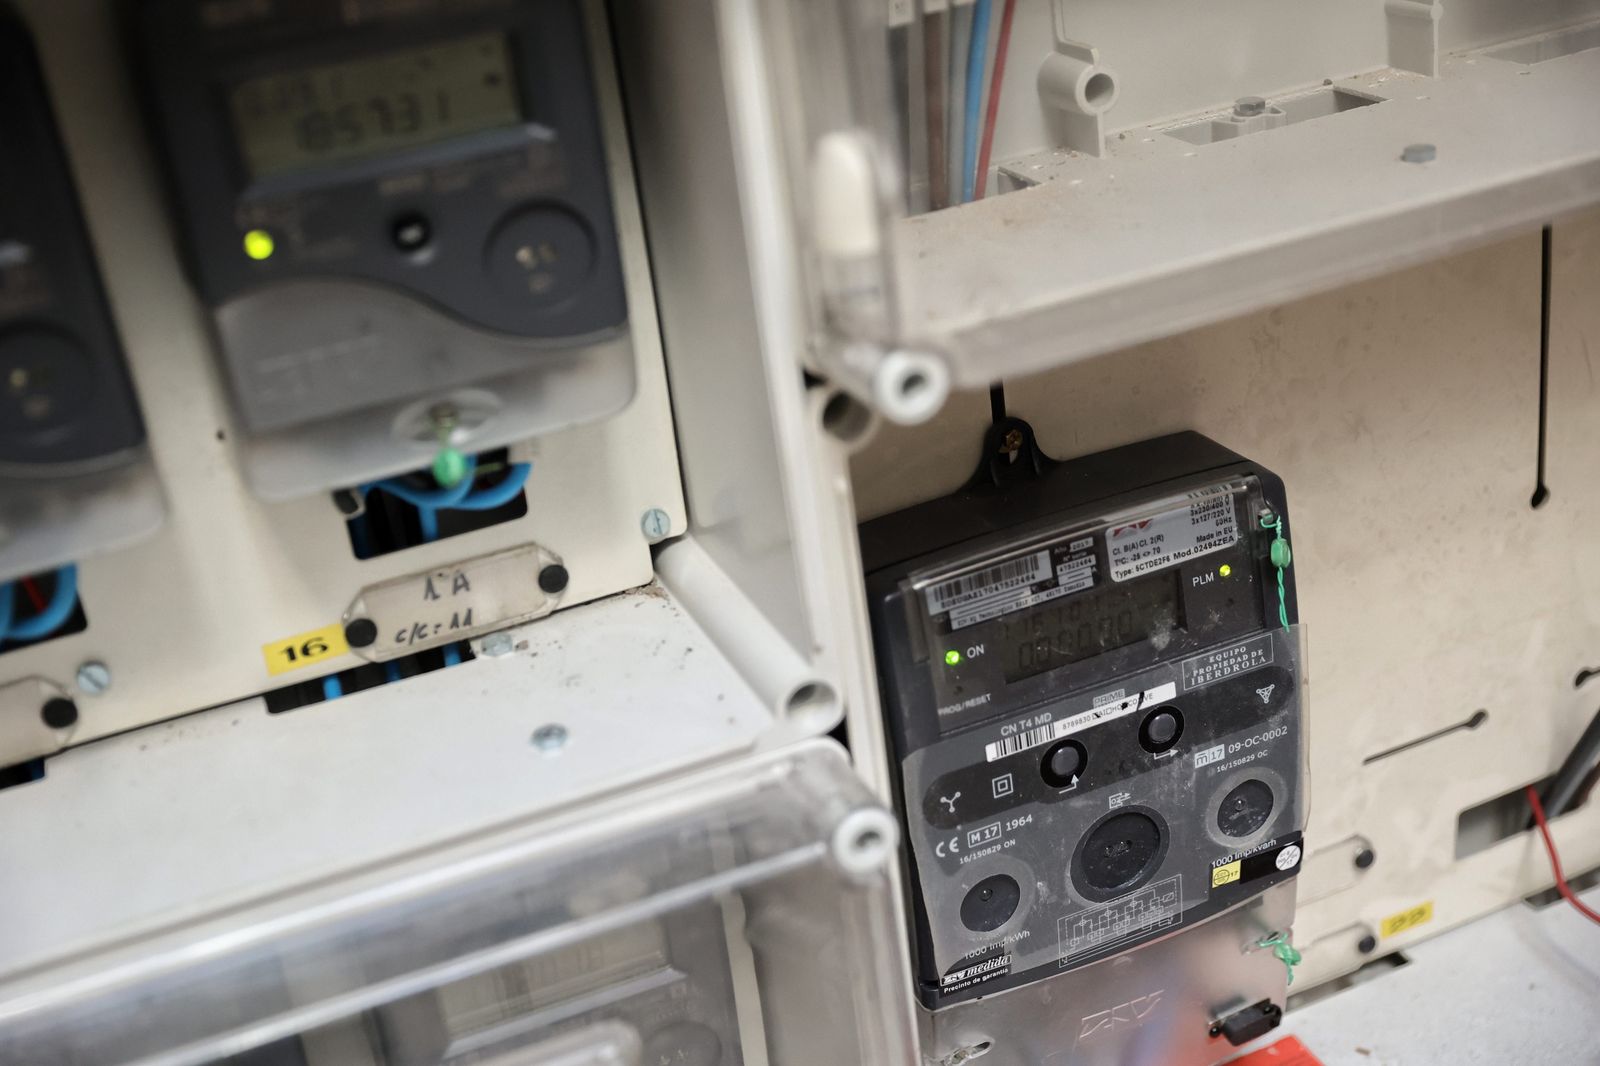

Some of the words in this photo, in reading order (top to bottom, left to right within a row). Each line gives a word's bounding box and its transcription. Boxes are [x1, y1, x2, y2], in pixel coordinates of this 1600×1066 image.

[1196, 532, 1215, 544] Made
[1223, 526, 1233, 535] EU
[1192, 572, 1215, 587] PLM
[279, 636, 328, 662] 16
[966, 644, 985, 658] ON
[1209, 646, 1247, 664] EQUIPO
[1191, 656, 1267, 686] IBERDROLA
[1192, 655, 1249, 677] PROPIEDAD
[1251, 649, 1264, 660] DE
[937, 694, 991, 717] PROG/RESET
[1000, 724, 1017, 736] CN
[1019, 719, 1032, 730] T4
[1035, 712, 1052, 724] MD
[1210, 747, 1224, 762] 17
[1228, 725, 1289, 754] 09-OC-0002
[1216, 754, 1255, 773] 16/150829
[1257, 749, 1269, 759] OC
[970, 832, 982, 844] M
[984, 826, 998, 840] 17
[1005, 814, 1033, 831] 1964
[1004, 839, 1016, 849] ON
[1212, 854, 1233, 868] 1000
[967, 955, 1009, 977] medida
[943, 980, 971, 994] Precinto
[973, 976, 982, 985] de
